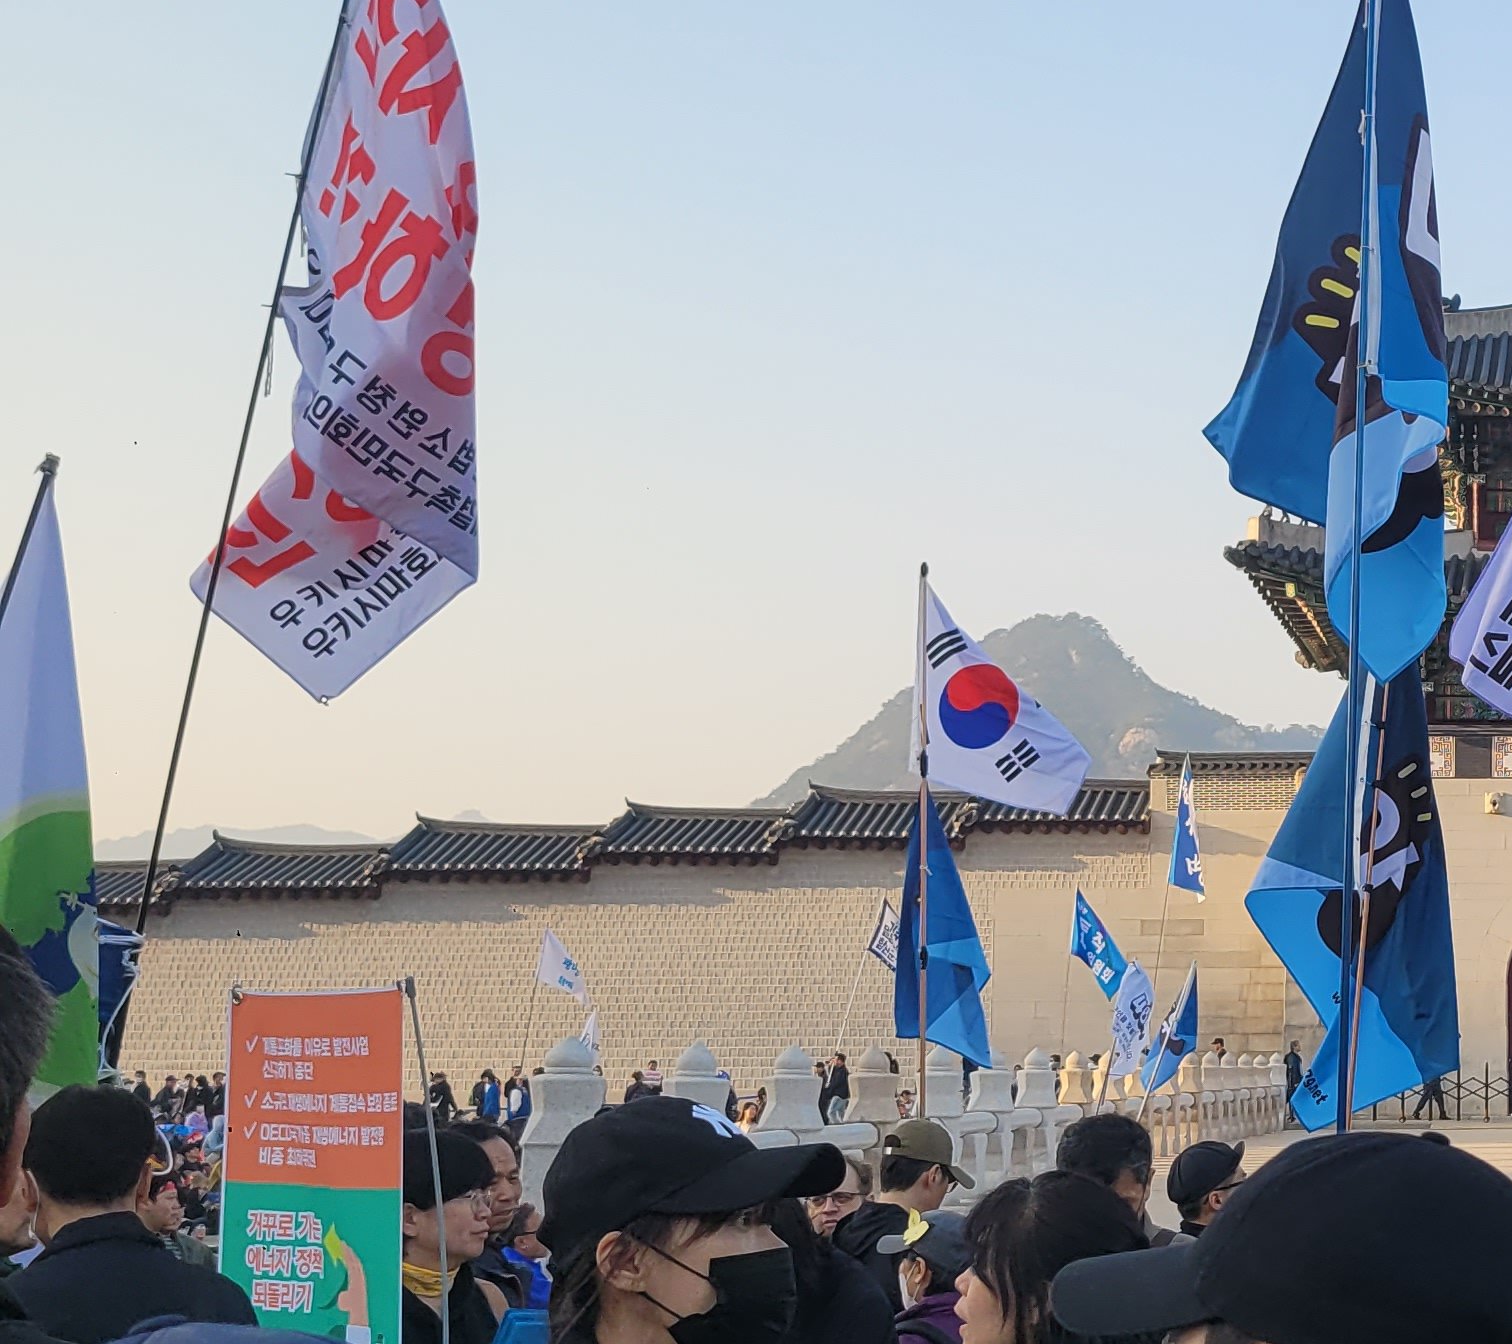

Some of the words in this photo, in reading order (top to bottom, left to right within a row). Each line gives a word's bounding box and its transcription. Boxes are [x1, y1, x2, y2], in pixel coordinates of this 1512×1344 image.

[270, 522, 406, 630] 우키시마
[302, 542, 444, 659] 우키시마호
[246, 1208, 298, 1242] 거꾸로
[298, 1210, 322, 1243] 가는
[245, 1245, 292, 1277] 에너지
[294, 1246, 324, 1280] 정책
[250, 1279, 315, 1313] 되돌리기
